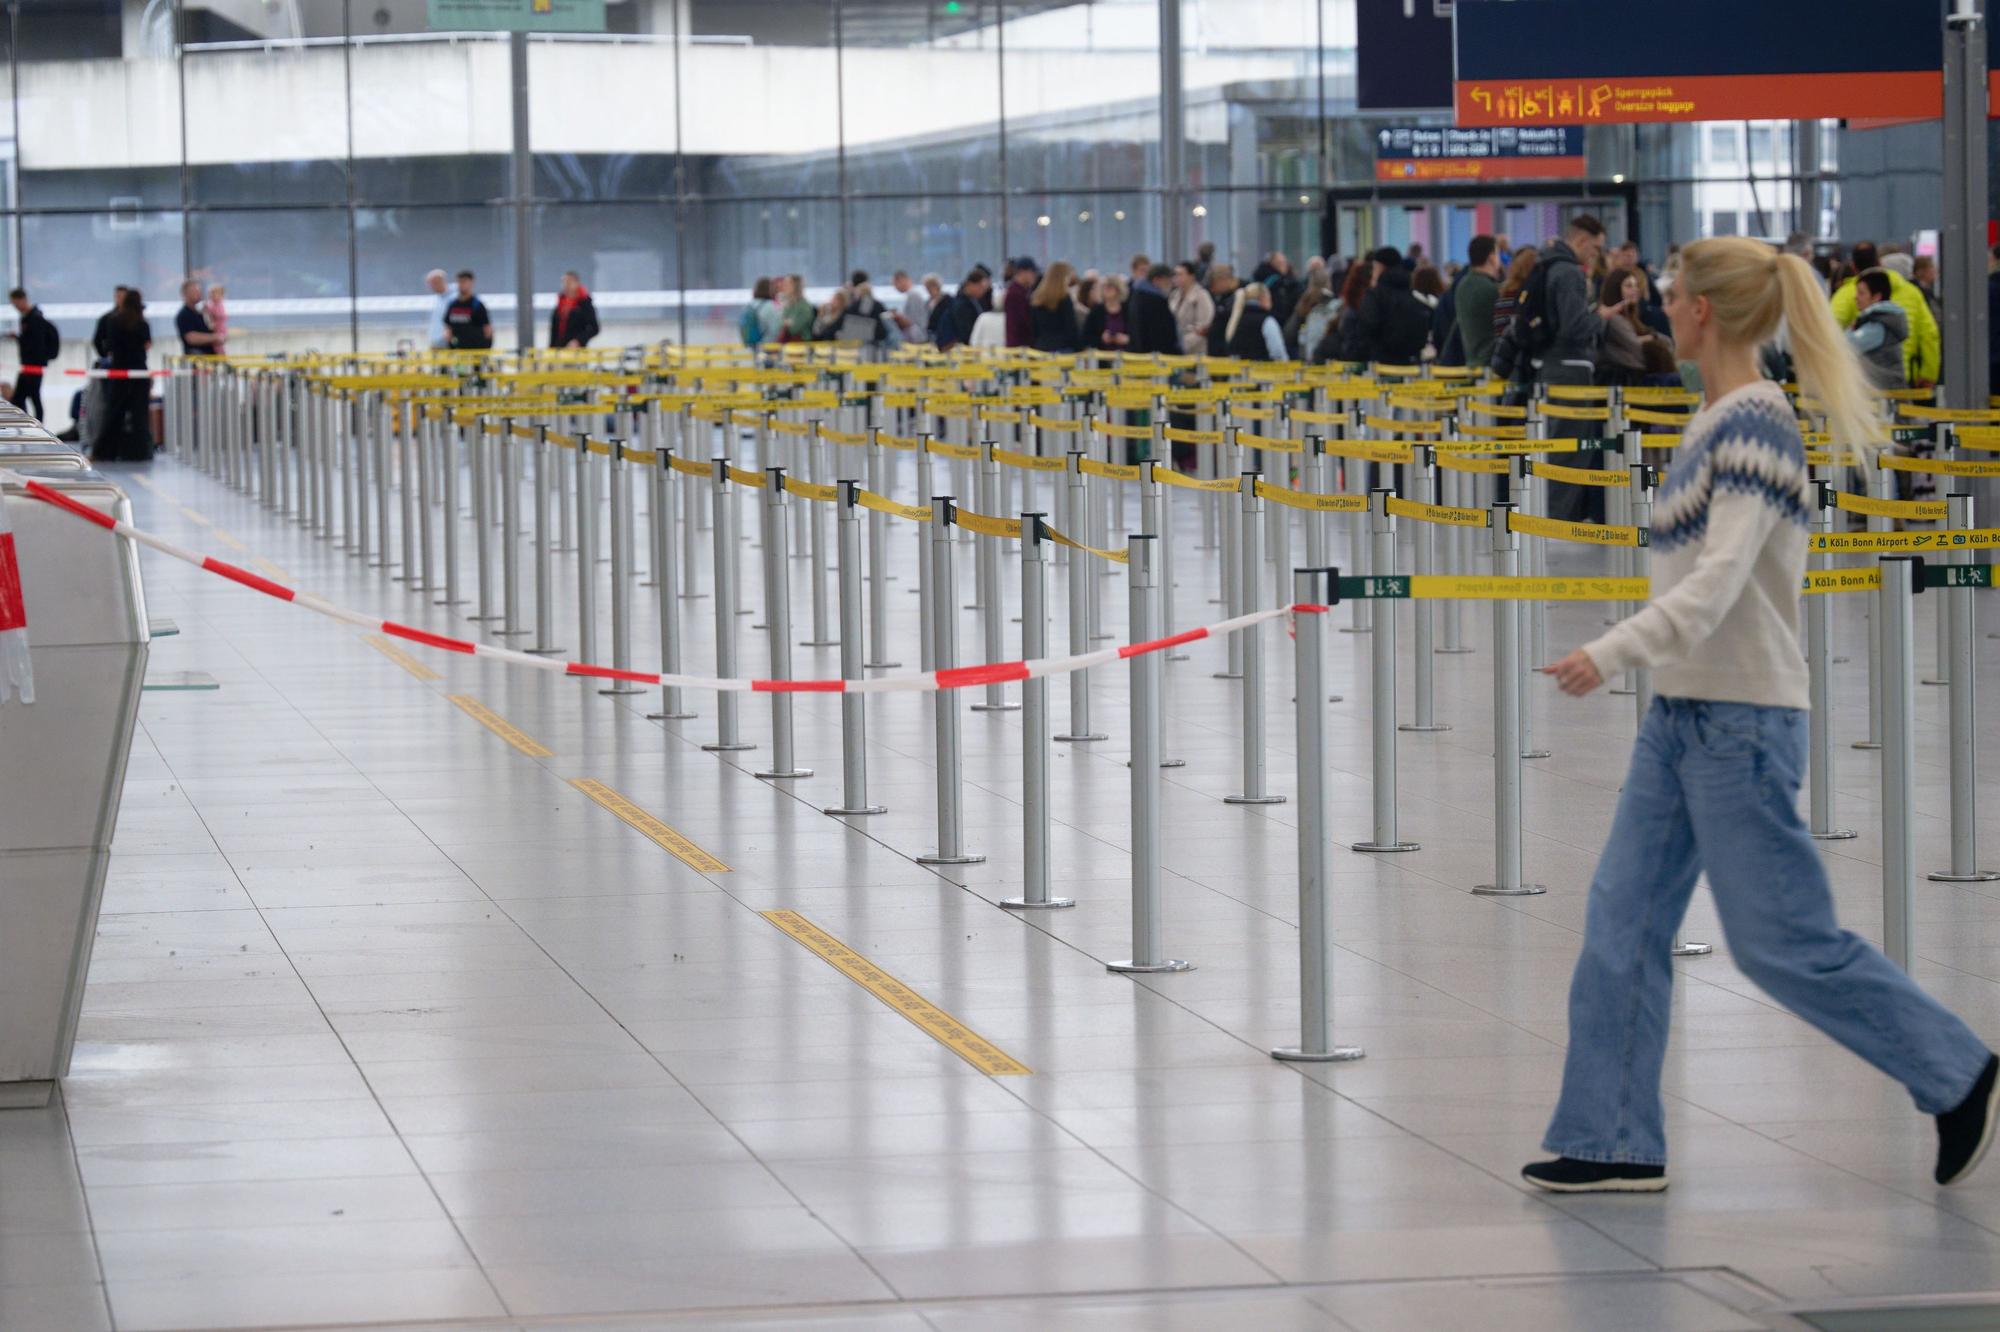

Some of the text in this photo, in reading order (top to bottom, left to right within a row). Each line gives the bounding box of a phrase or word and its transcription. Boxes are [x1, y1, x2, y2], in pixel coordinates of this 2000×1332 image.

[1830, 537, 1849, 548] Köln
[1852, 537, 1873, 547] Bonn
[1876, 536, 1909, 549] Airport
[1969, 533, 1989, 543] Köln
[1815, 576, 1837, 587] Köln
[1840, 576, 1865, 586] Bonn
